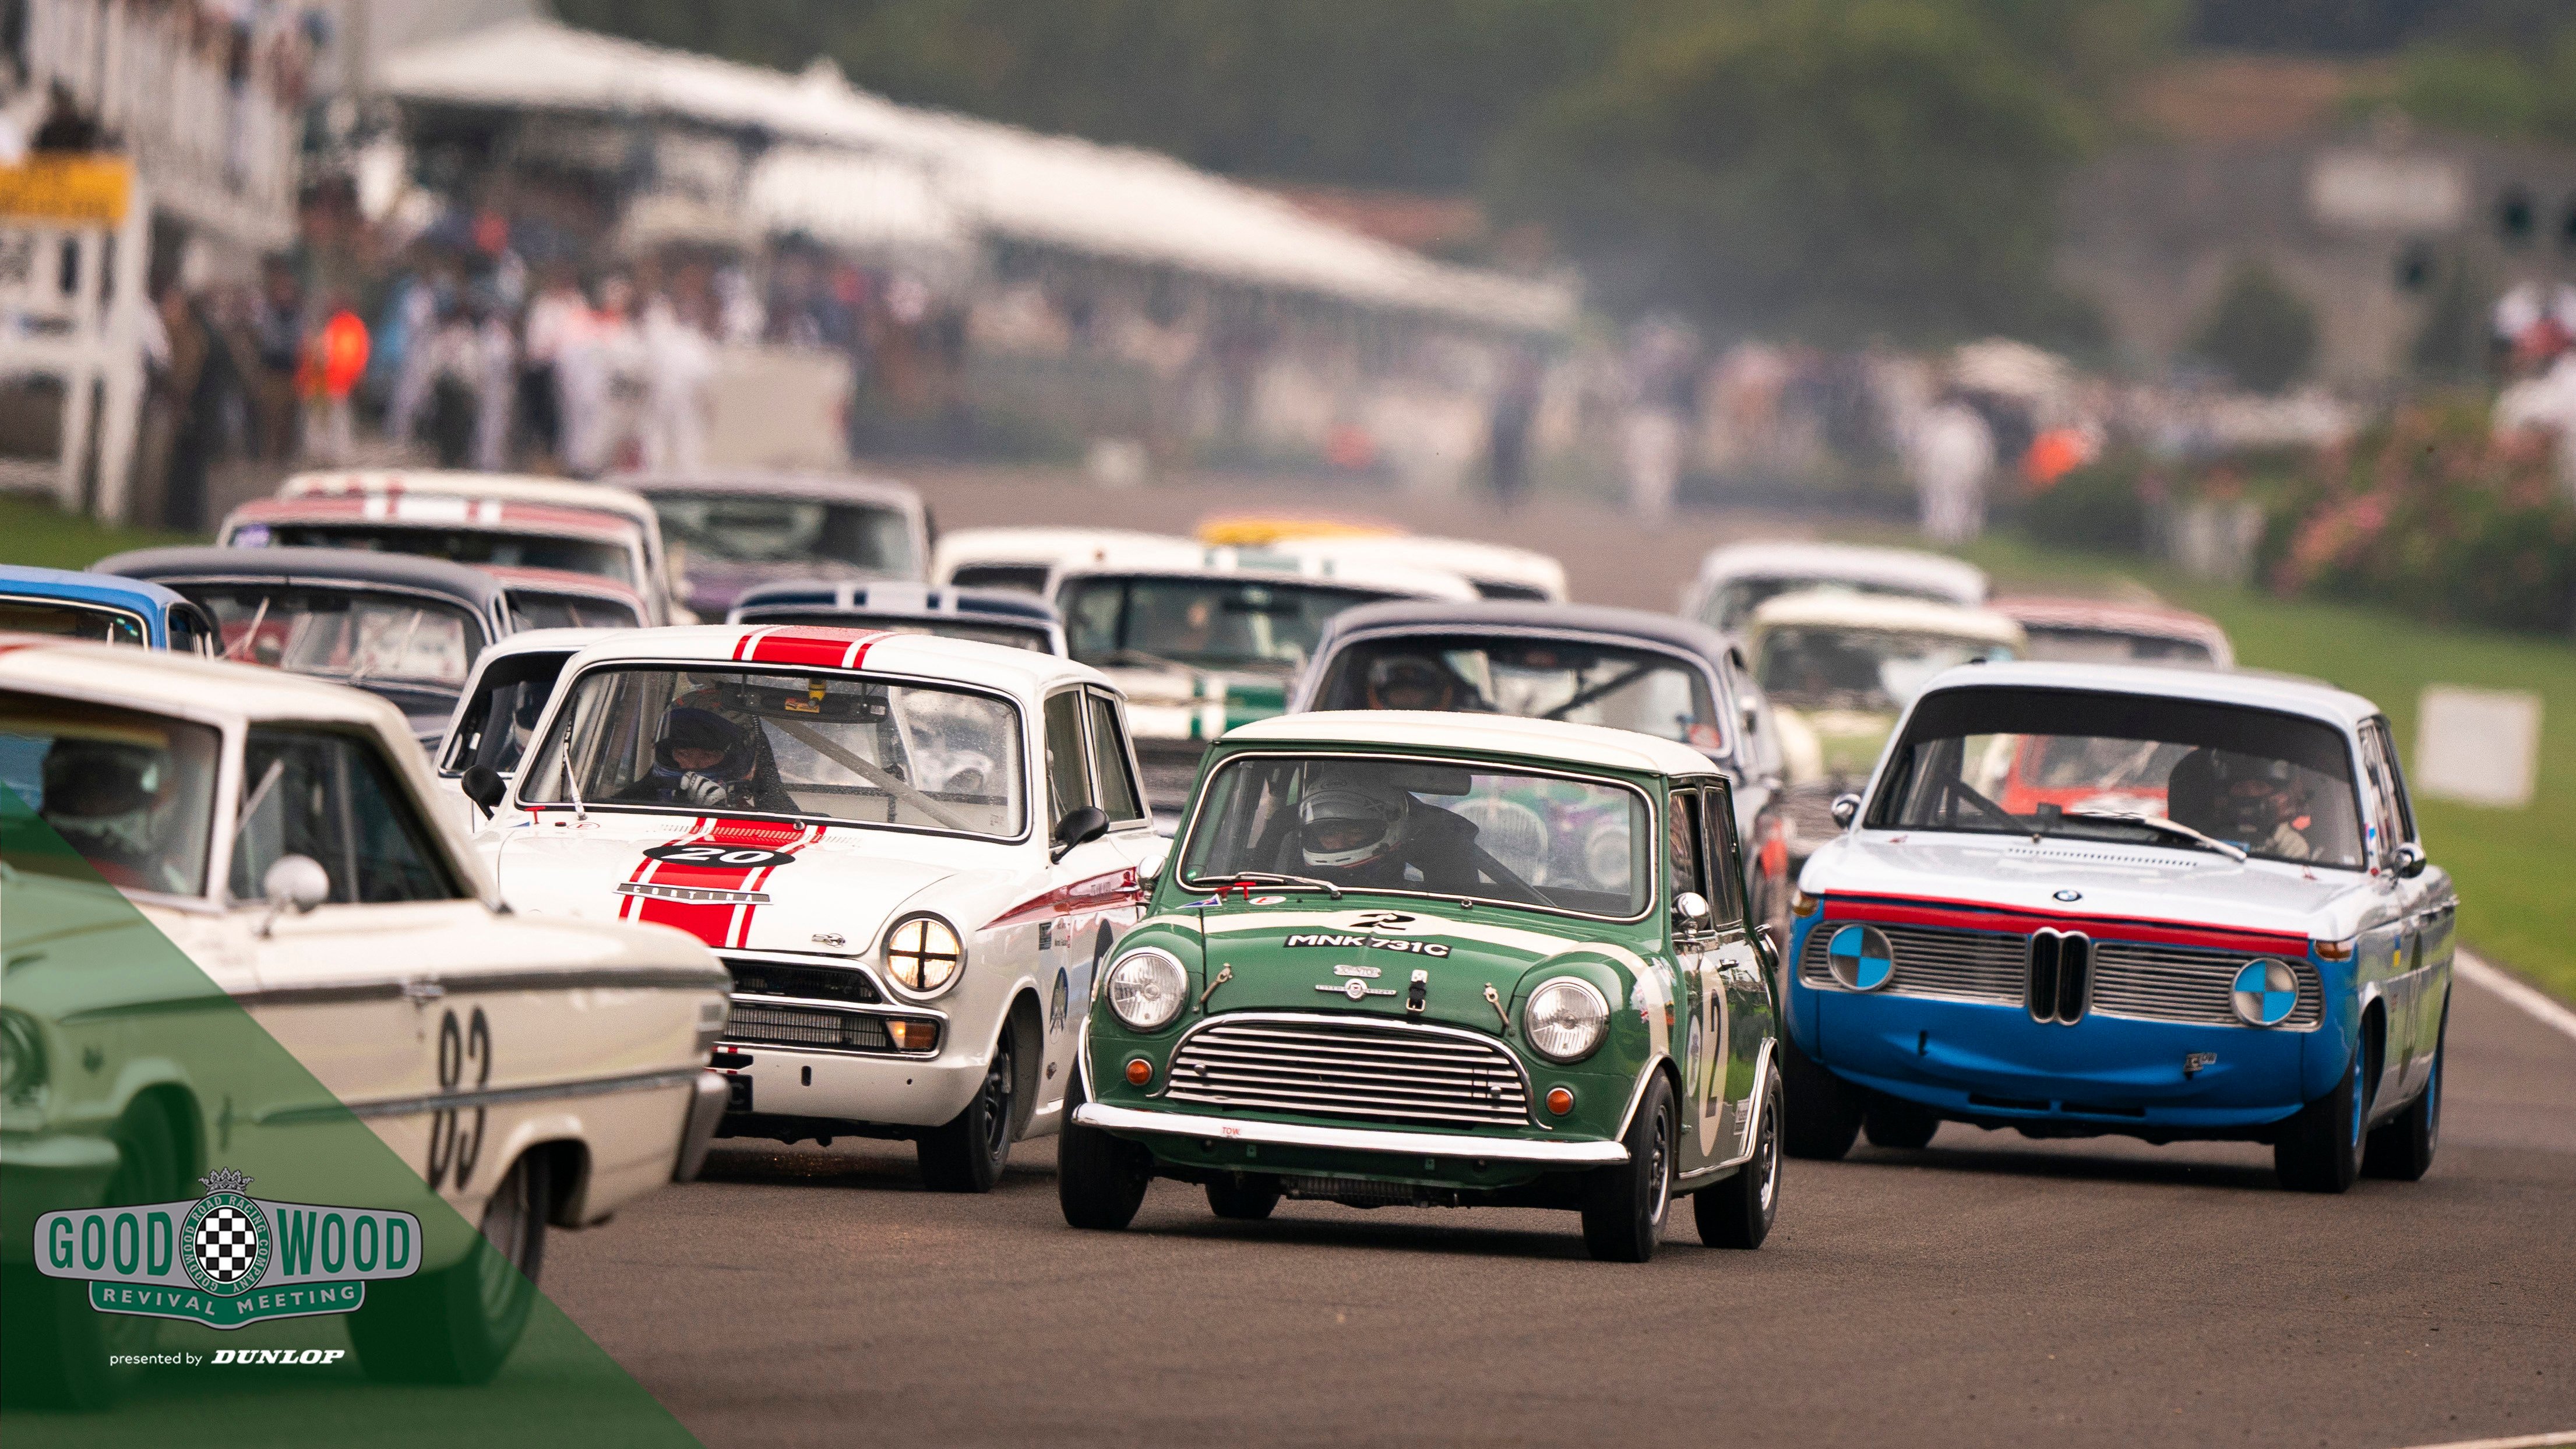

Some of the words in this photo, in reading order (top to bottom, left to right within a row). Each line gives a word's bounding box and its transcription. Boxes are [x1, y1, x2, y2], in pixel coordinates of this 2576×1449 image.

[660, 847, 778, 863] 20
[632, 885, 753, 902] CORTINA
[1349, 912, 1416, 931] 2
[1287, 934, 1366, 947] MNK
[1369, 937, 1450, 956] 731C
[1705, 988, 1722, 1118] 2
[427, 1006, 491, 1191] 83
[1221, 1126, 1241, 1136] TOW
